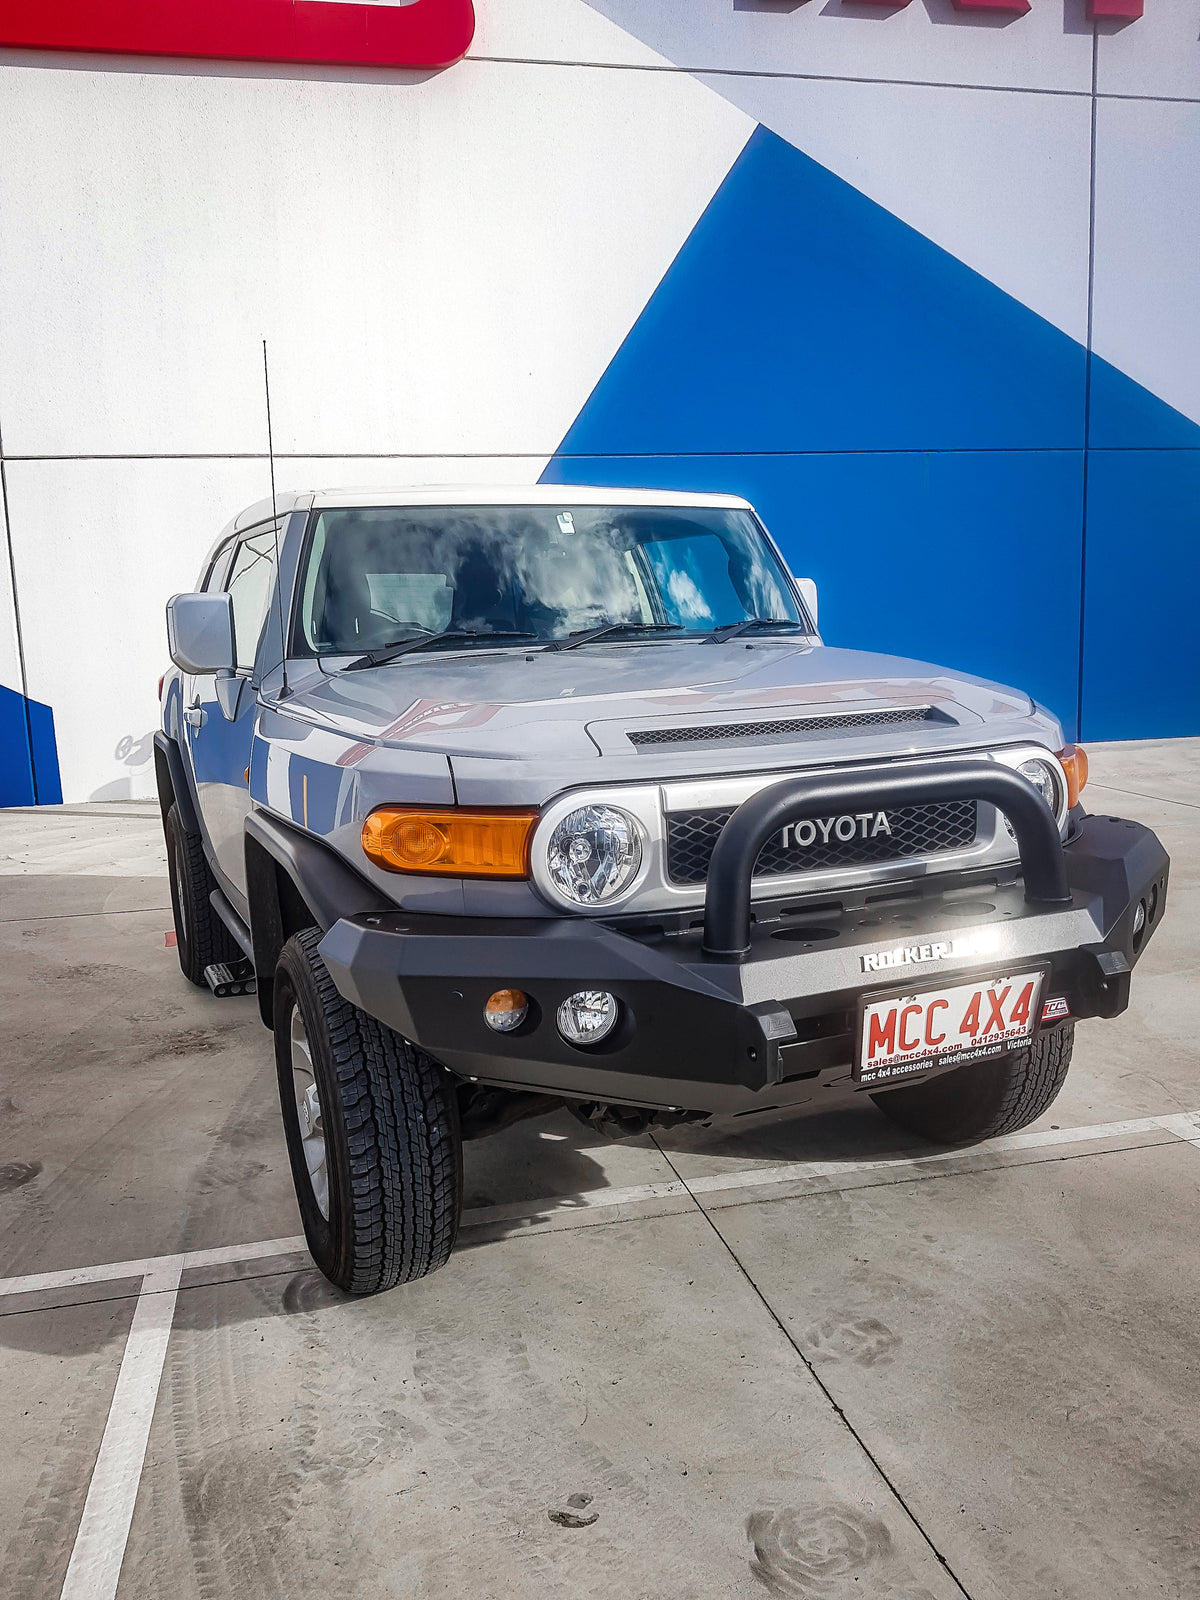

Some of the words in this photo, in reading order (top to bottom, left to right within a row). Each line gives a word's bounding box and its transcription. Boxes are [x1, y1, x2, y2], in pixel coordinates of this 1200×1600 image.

[782, 811, 892, 848] TOYOTA
[867, 999, 949, 1060] MCC
[959, 981, 1034, 1038] 4X4
[861, 1072, 876, 1082] mcc
[877, 1066, 891, 1078] 4x4
[892, 1059, 933, 1076] accessories
[938, 1044, 1002, 1066] sales@mcc4x4.com
[1007, 1036, 1032, 1051] Victoria
[867, 1042, 962, 1068] sales@mcc4x4.com
[971, 1026, 1027, 1047] 0412935643
